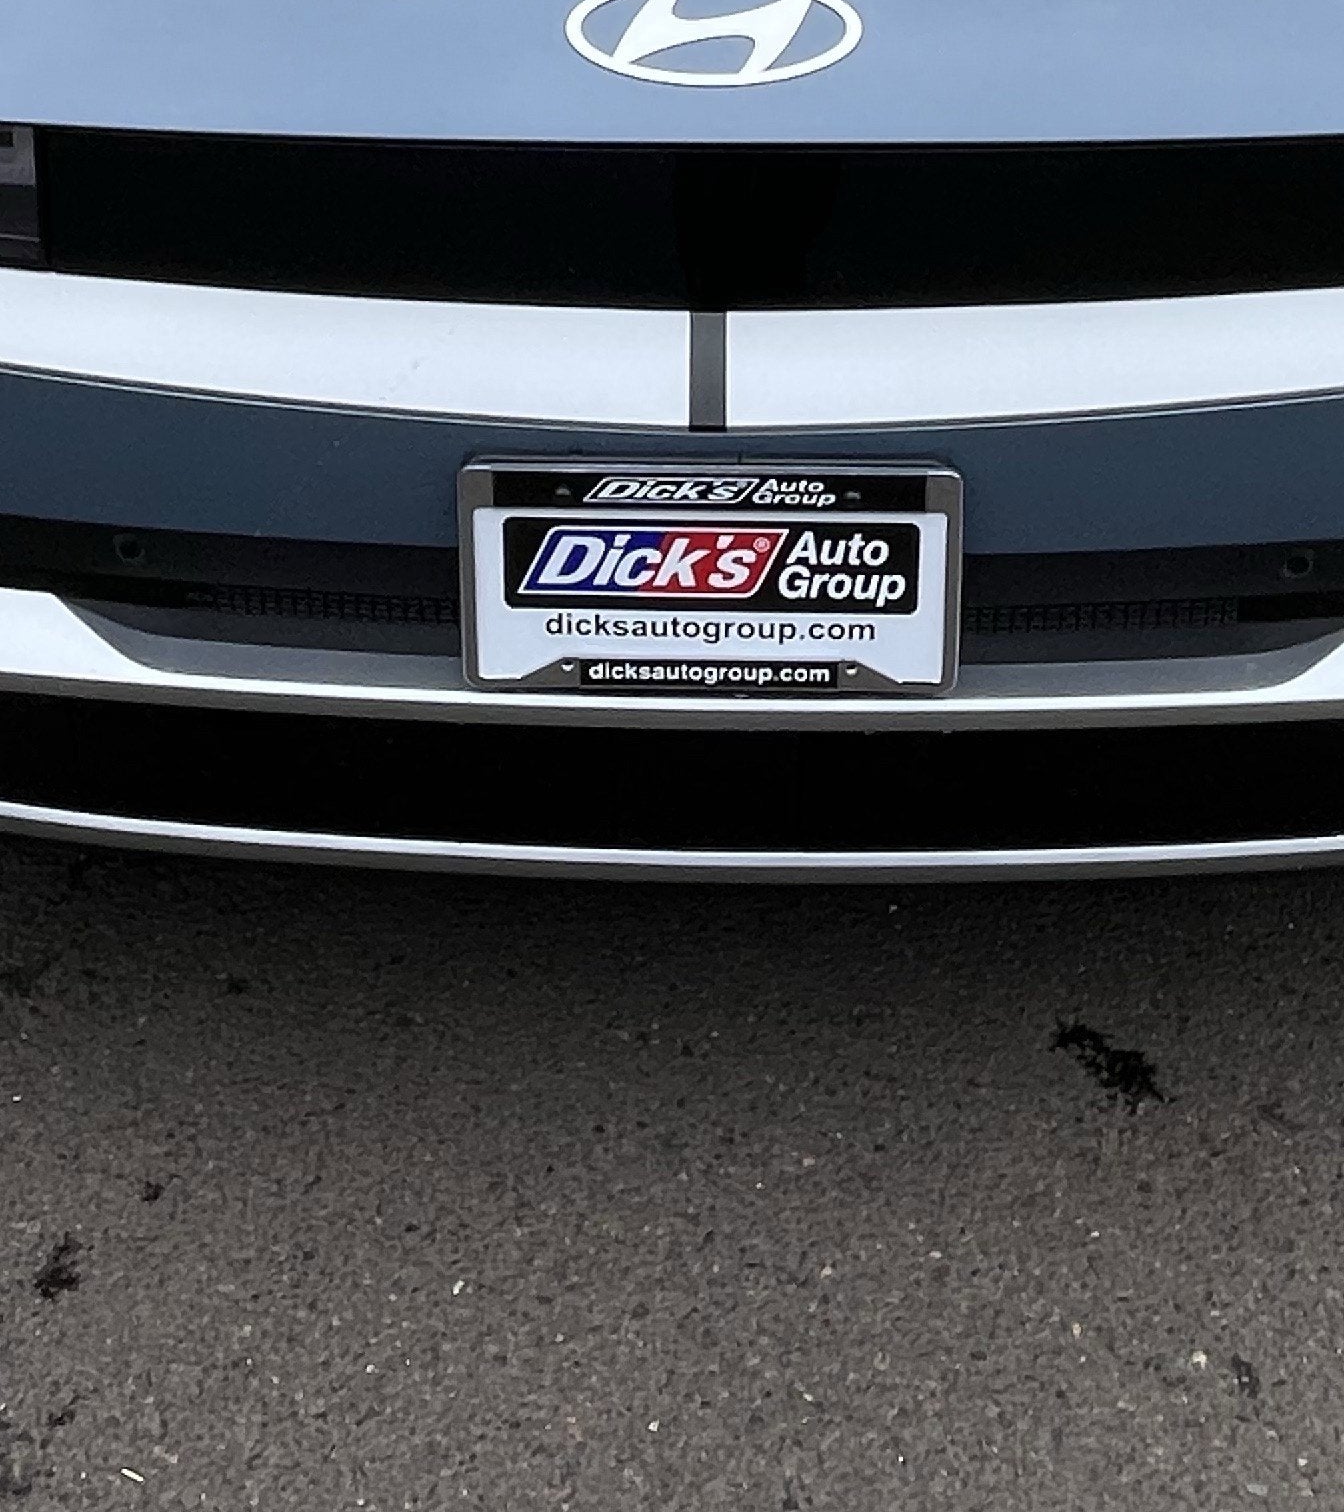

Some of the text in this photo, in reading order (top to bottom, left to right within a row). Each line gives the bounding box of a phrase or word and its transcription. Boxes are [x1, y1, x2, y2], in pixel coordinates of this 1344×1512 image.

[761, 479, 824, 492] Auto
[752, 490, 836, 508] Group
[537, 531, 889, 588] Dick's Auto
[778, 567, 906, 607] Group
[545, 614, 876, 644] dicksautogroup.com
[588, 662, 830, 685] dicksautogroup.com
